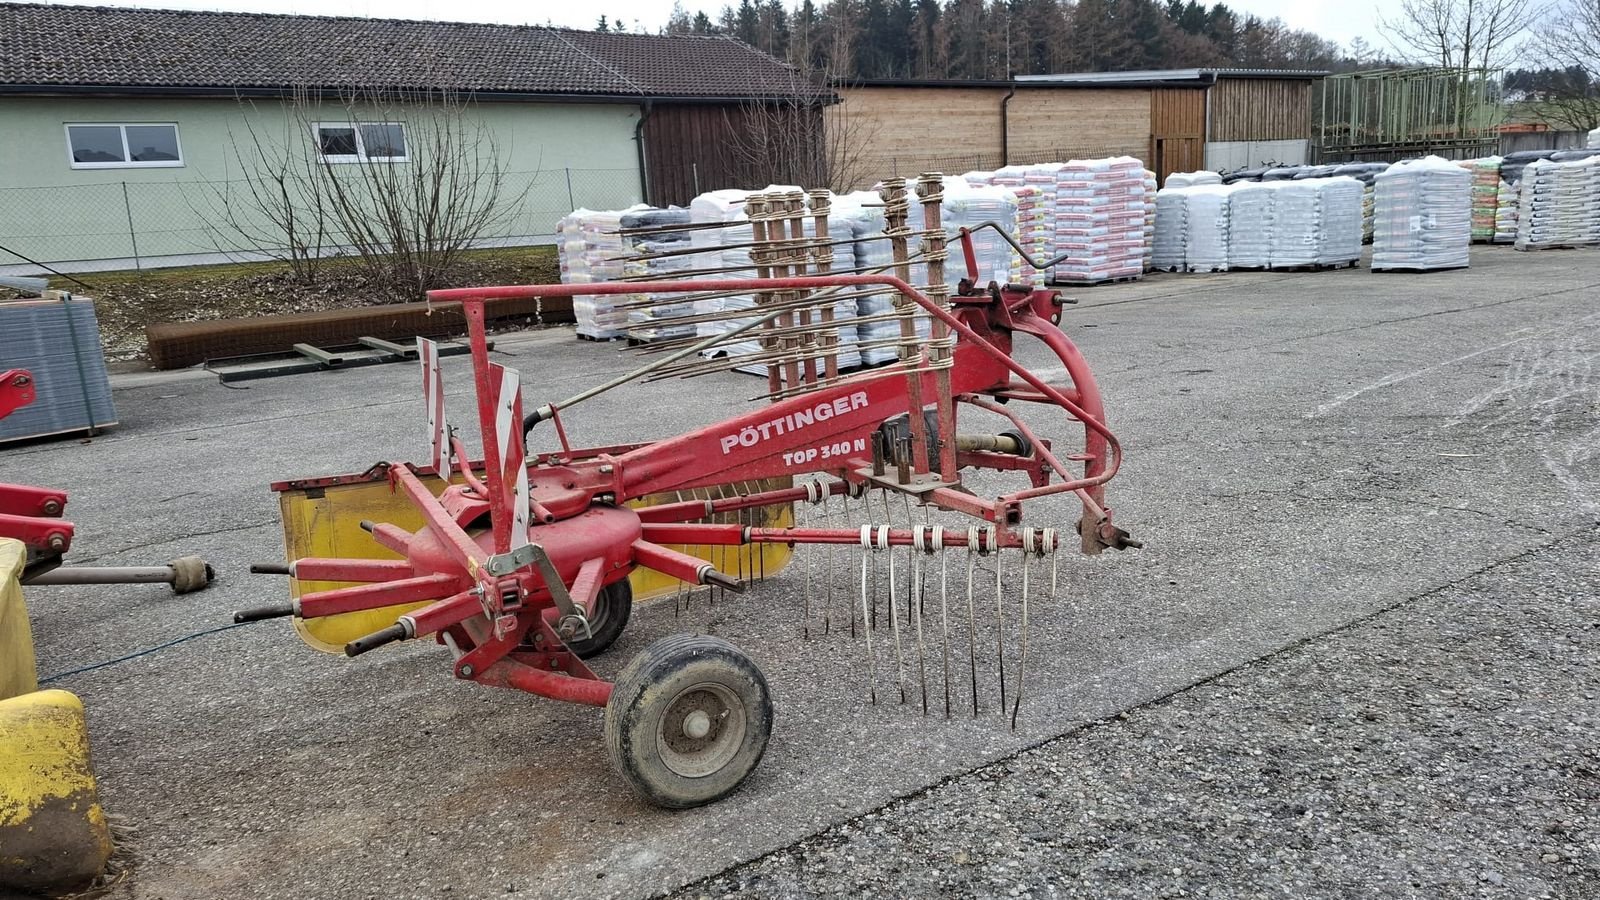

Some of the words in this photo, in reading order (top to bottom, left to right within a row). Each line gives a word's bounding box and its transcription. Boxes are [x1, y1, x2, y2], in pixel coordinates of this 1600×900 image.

[720, 391, 869, 454] PÖTTINGER
[783, 449, 818, 466] TOP
[821, 441, 851, 459] 340
[854, 439, 866, 452] N
